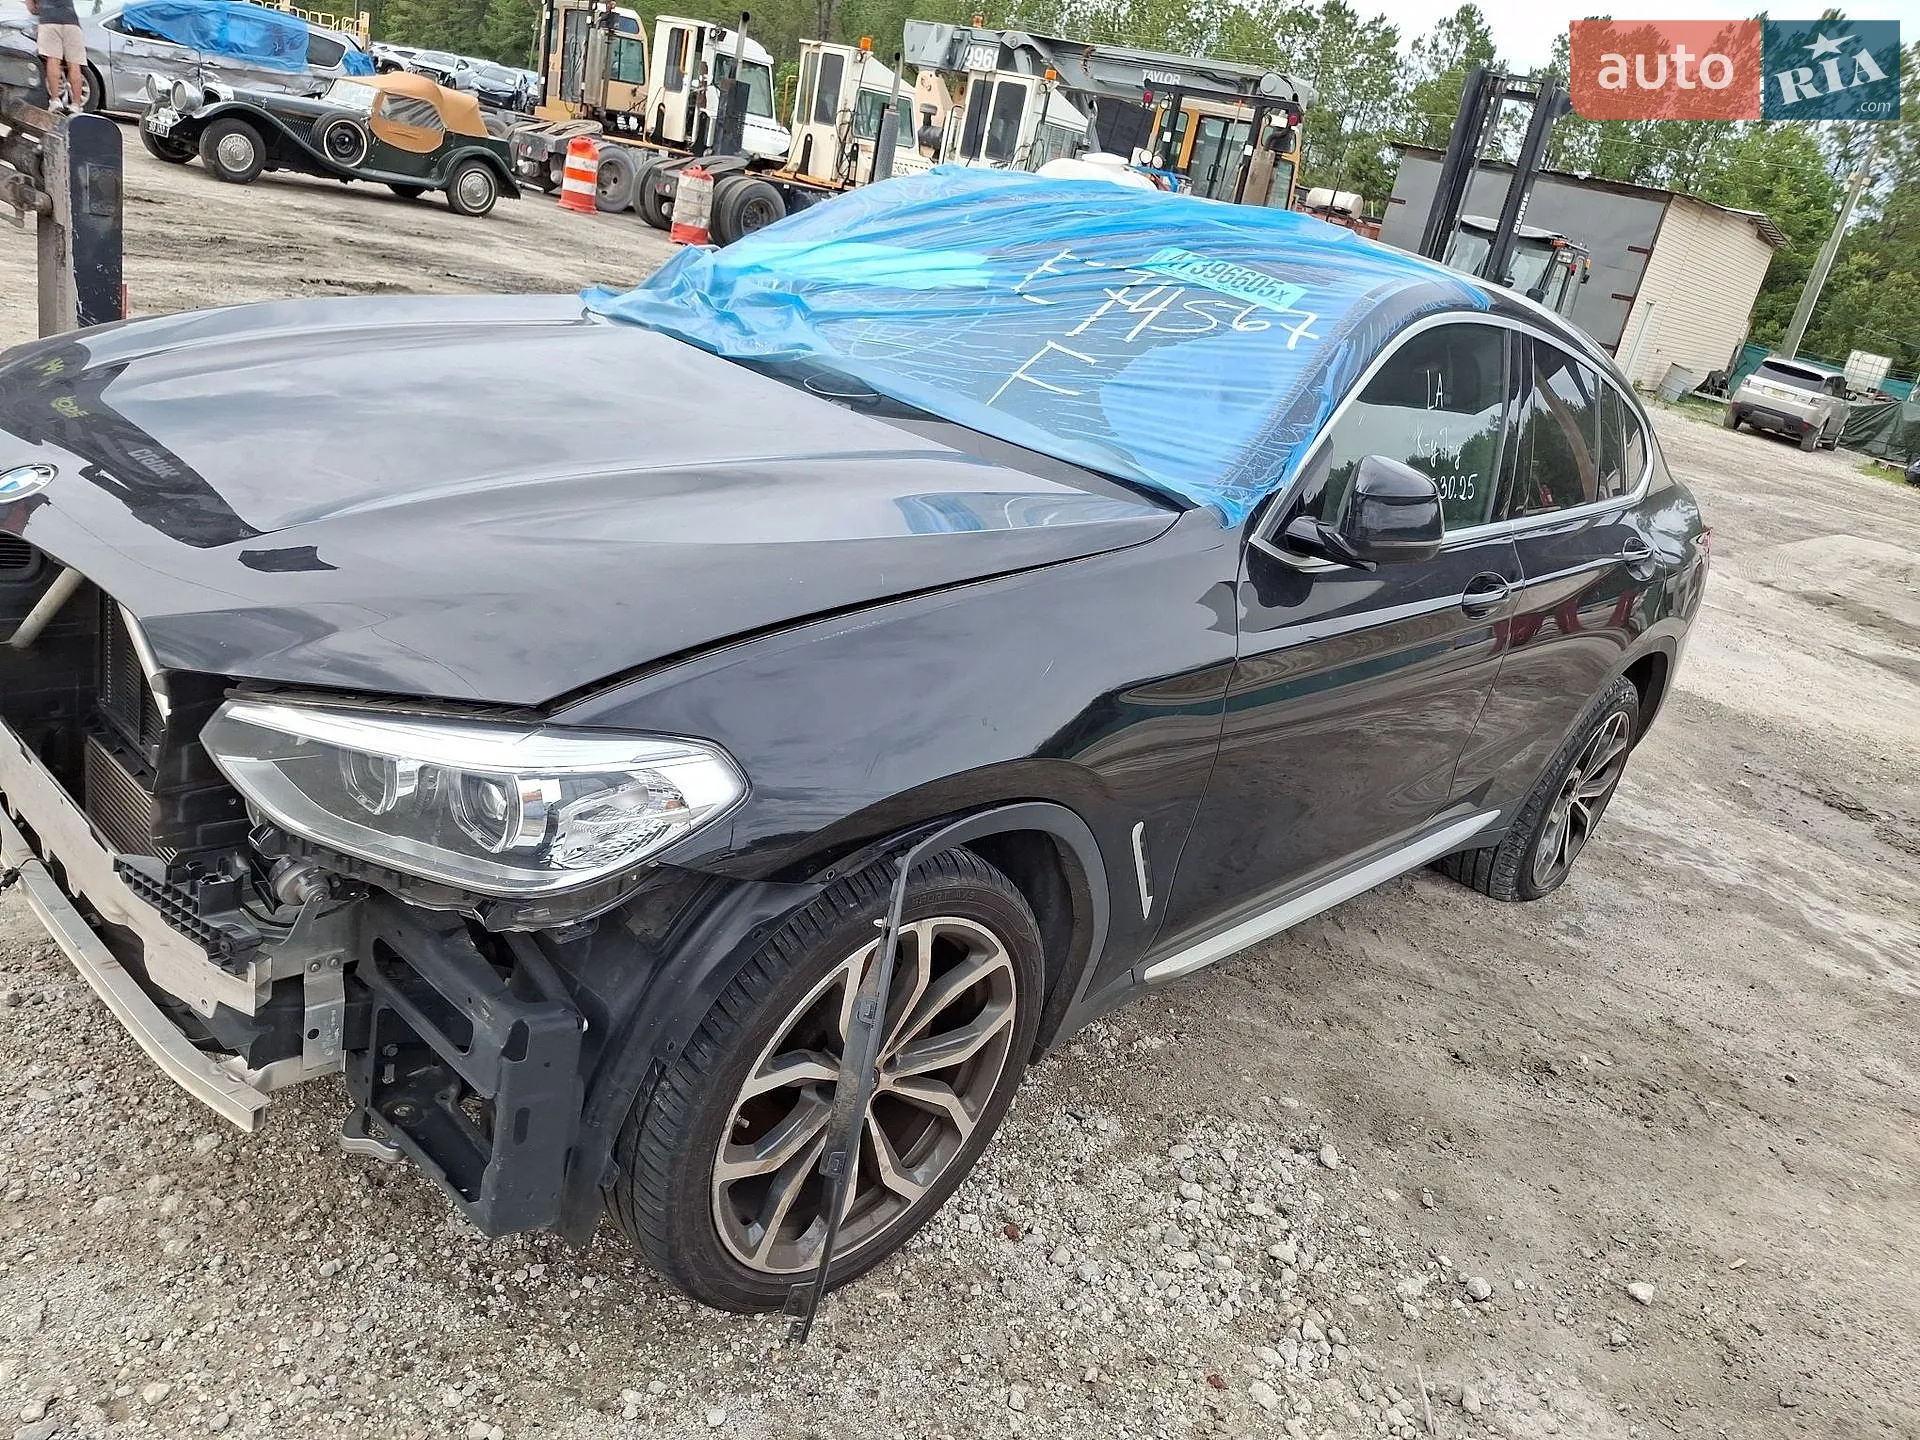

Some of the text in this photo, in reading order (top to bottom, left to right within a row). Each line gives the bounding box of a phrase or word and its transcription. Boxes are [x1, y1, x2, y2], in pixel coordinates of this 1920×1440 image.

[1142, 69, 1181, 85] TAYLOR
[1513, 192, 1530, 234] CLARK
[986, 340, 1097, 405] F
[1426, 369, 1444, 410] LA
[1431, 473, 1478, 500] 30.25
